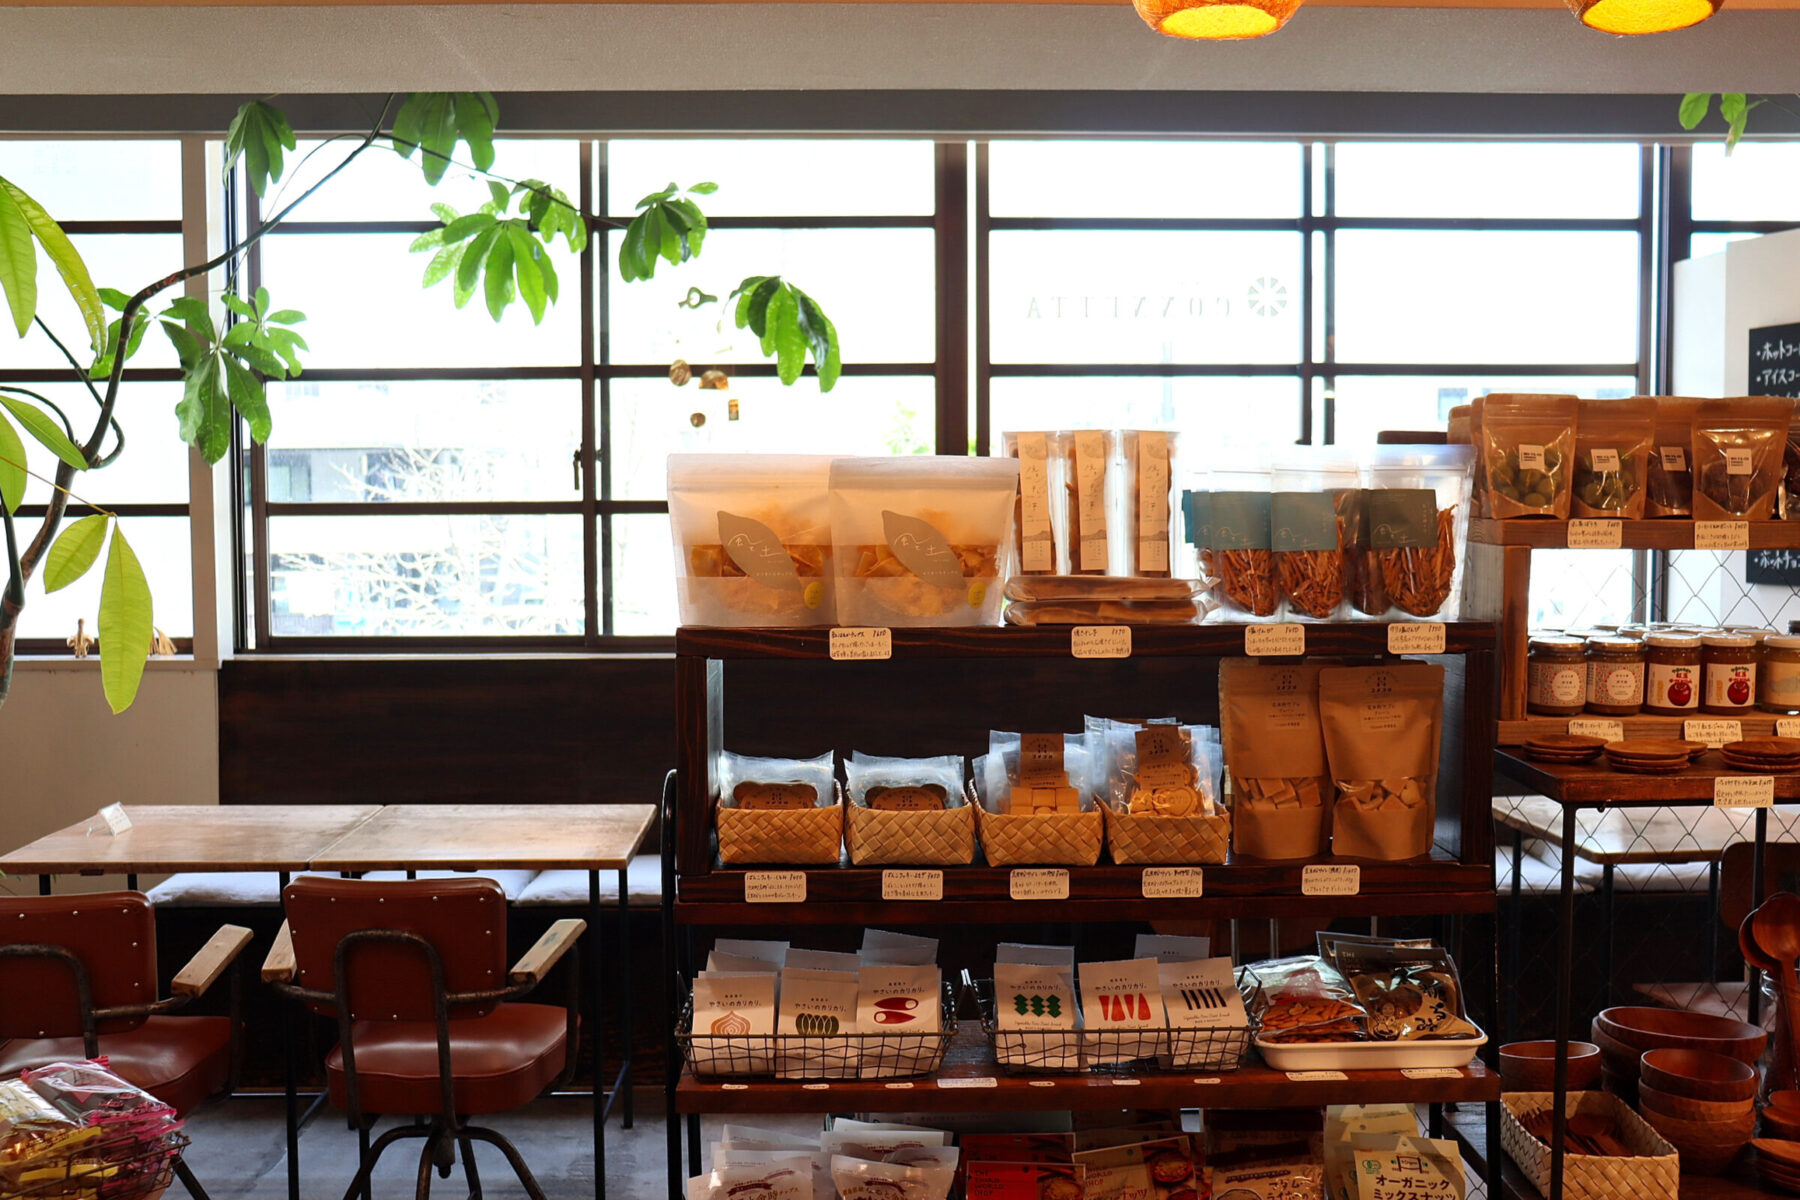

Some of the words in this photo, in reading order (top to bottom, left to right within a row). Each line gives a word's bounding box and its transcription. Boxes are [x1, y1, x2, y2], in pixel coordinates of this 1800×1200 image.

[1761, 339, 1800, 361] ホットコー
[1375, 1174, 1450, 1191] オーガニック
